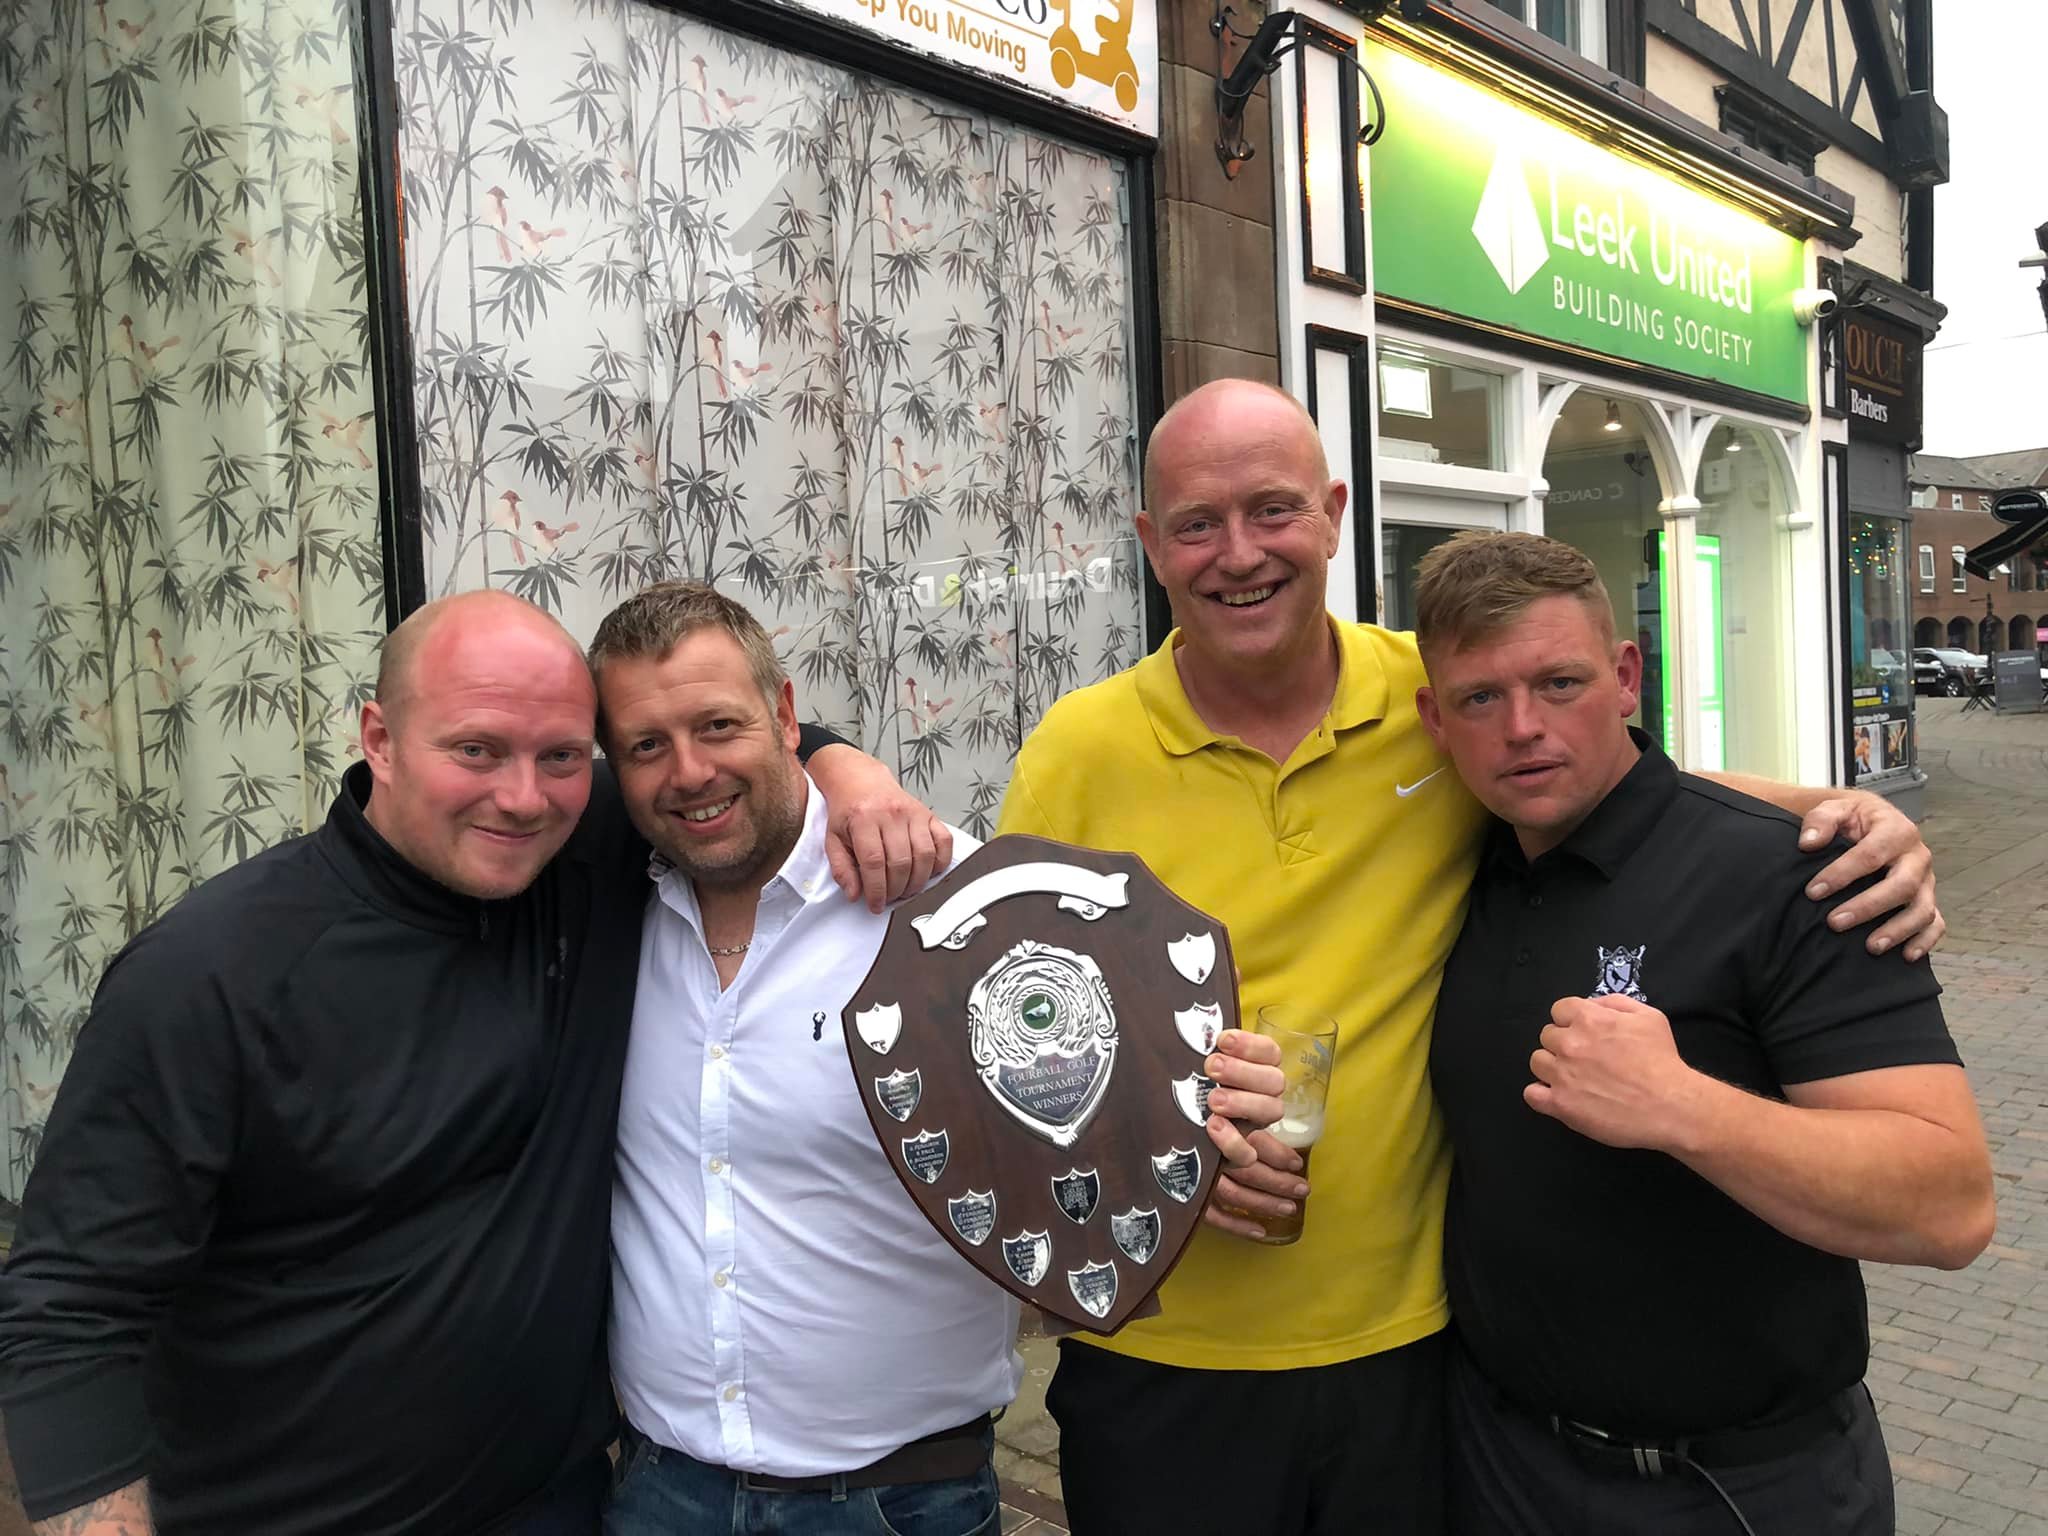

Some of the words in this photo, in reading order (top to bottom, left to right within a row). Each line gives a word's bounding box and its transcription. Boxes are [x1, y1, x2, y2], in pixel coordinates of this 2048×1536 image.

[897, 0, 938, 34] You
[947, 10, 1026, 73] Moving
[1551, 177, 1640, 275] Leek
[1650, 207, 1752, 315] United
[1553, 275, 1665, 341] BUILDING
[1673, 315, 1753, 366] SOCIETY
[1850, 388, 1889, 424] Barbers
[1007, 1063, 1065, 1085] FOURBALL
[1066, 1055, 1096, 1071] GOLF
[1015, 1073, 1093, 1099] TOURNAMENT
[1032, 1090, 1083, 1110] WINNERS
